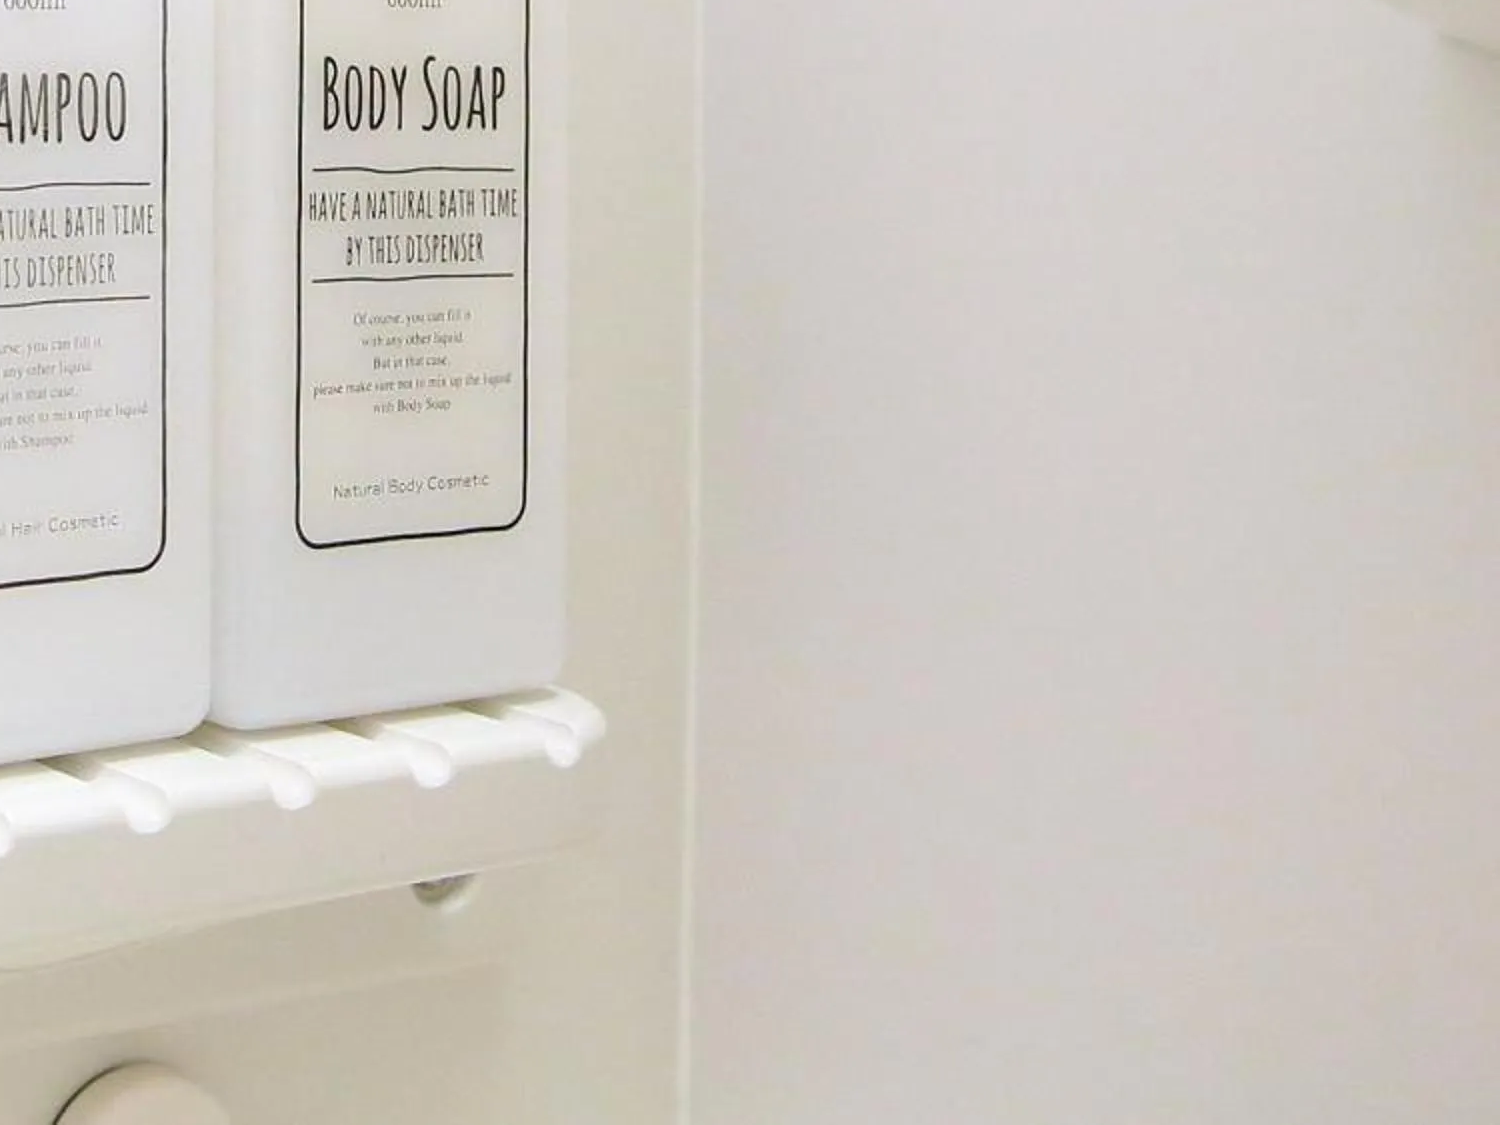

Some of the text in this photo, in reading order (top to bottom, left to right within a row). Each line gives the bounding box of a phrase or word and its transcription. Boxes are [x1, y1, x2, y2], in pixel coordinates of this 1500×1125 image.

[324, 55, 505, 132] BODY SOAP
[65, 206, 105, 237] BATH
[112, 204, 156, 236] TIME
[309, 187, 517, 221] HAVE A NATURAL BATH TIME
[346, 232, 484, 265] BY THIS DISPENSER
[27, 253, 117, 288] DISPENSER
[334, 474, 489, 499] Natural Body Cosmetic
[48, 514, 118, 533] Cosmetic
